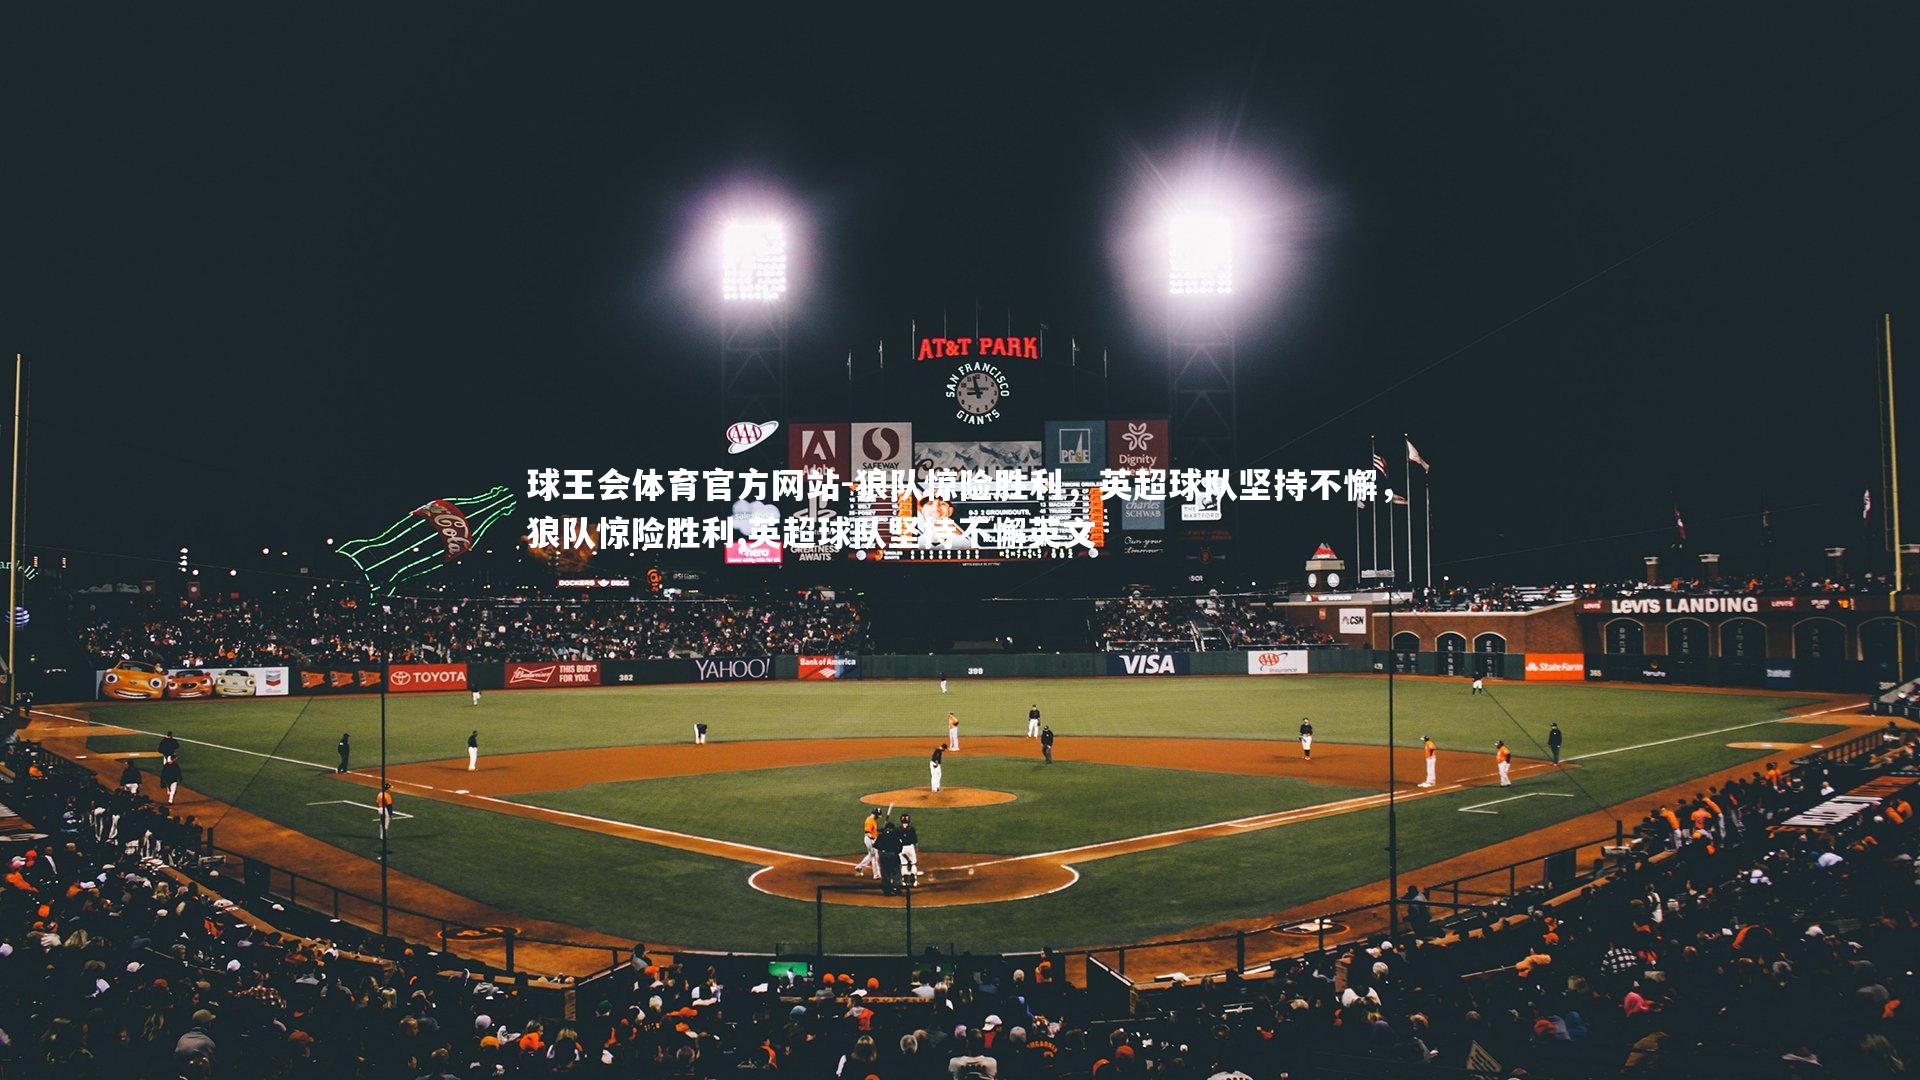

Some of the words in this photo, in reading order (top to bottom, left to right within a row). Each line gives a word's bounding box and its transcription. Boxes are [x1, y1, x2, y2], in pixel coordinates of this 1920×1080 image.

[917, 337, 973, 361] AT&T
[979, 336, 1039, 360] PARK
[945, 373, 960, 398] SAN
[957, 361, 1010, 397] FRANCISCO
[956, 408, 1001, 425] GIANTS
[1118, 454, 1157, 466] Dignity
[862, 462, 900, 470] SAFEWAY
[1124, 510, 1162, 518] SCHWAB
[790, 545, 840, 553] GREATNESS
[798, 552, 832, 562] AWAITS
[558, 579, 596, 587] DOCKERS
[1665, 597, 1758, 613] LANDING
[1350, 616, 1364, 625] CSN
[800, 657, 818, 666] Bank
[818, 657, 827, 666] of
[827, 657, 857, 666] America
[1119, 655, 1176, 674] VISA
[559, 665, 576, 673] THIS
[576, 664, 598, 673] BUD'S
[695, 658, 771, 681] YAHOO!
[412, 671, 467, 683] TOYOTA
[559, 674, 573, 683] FOR
